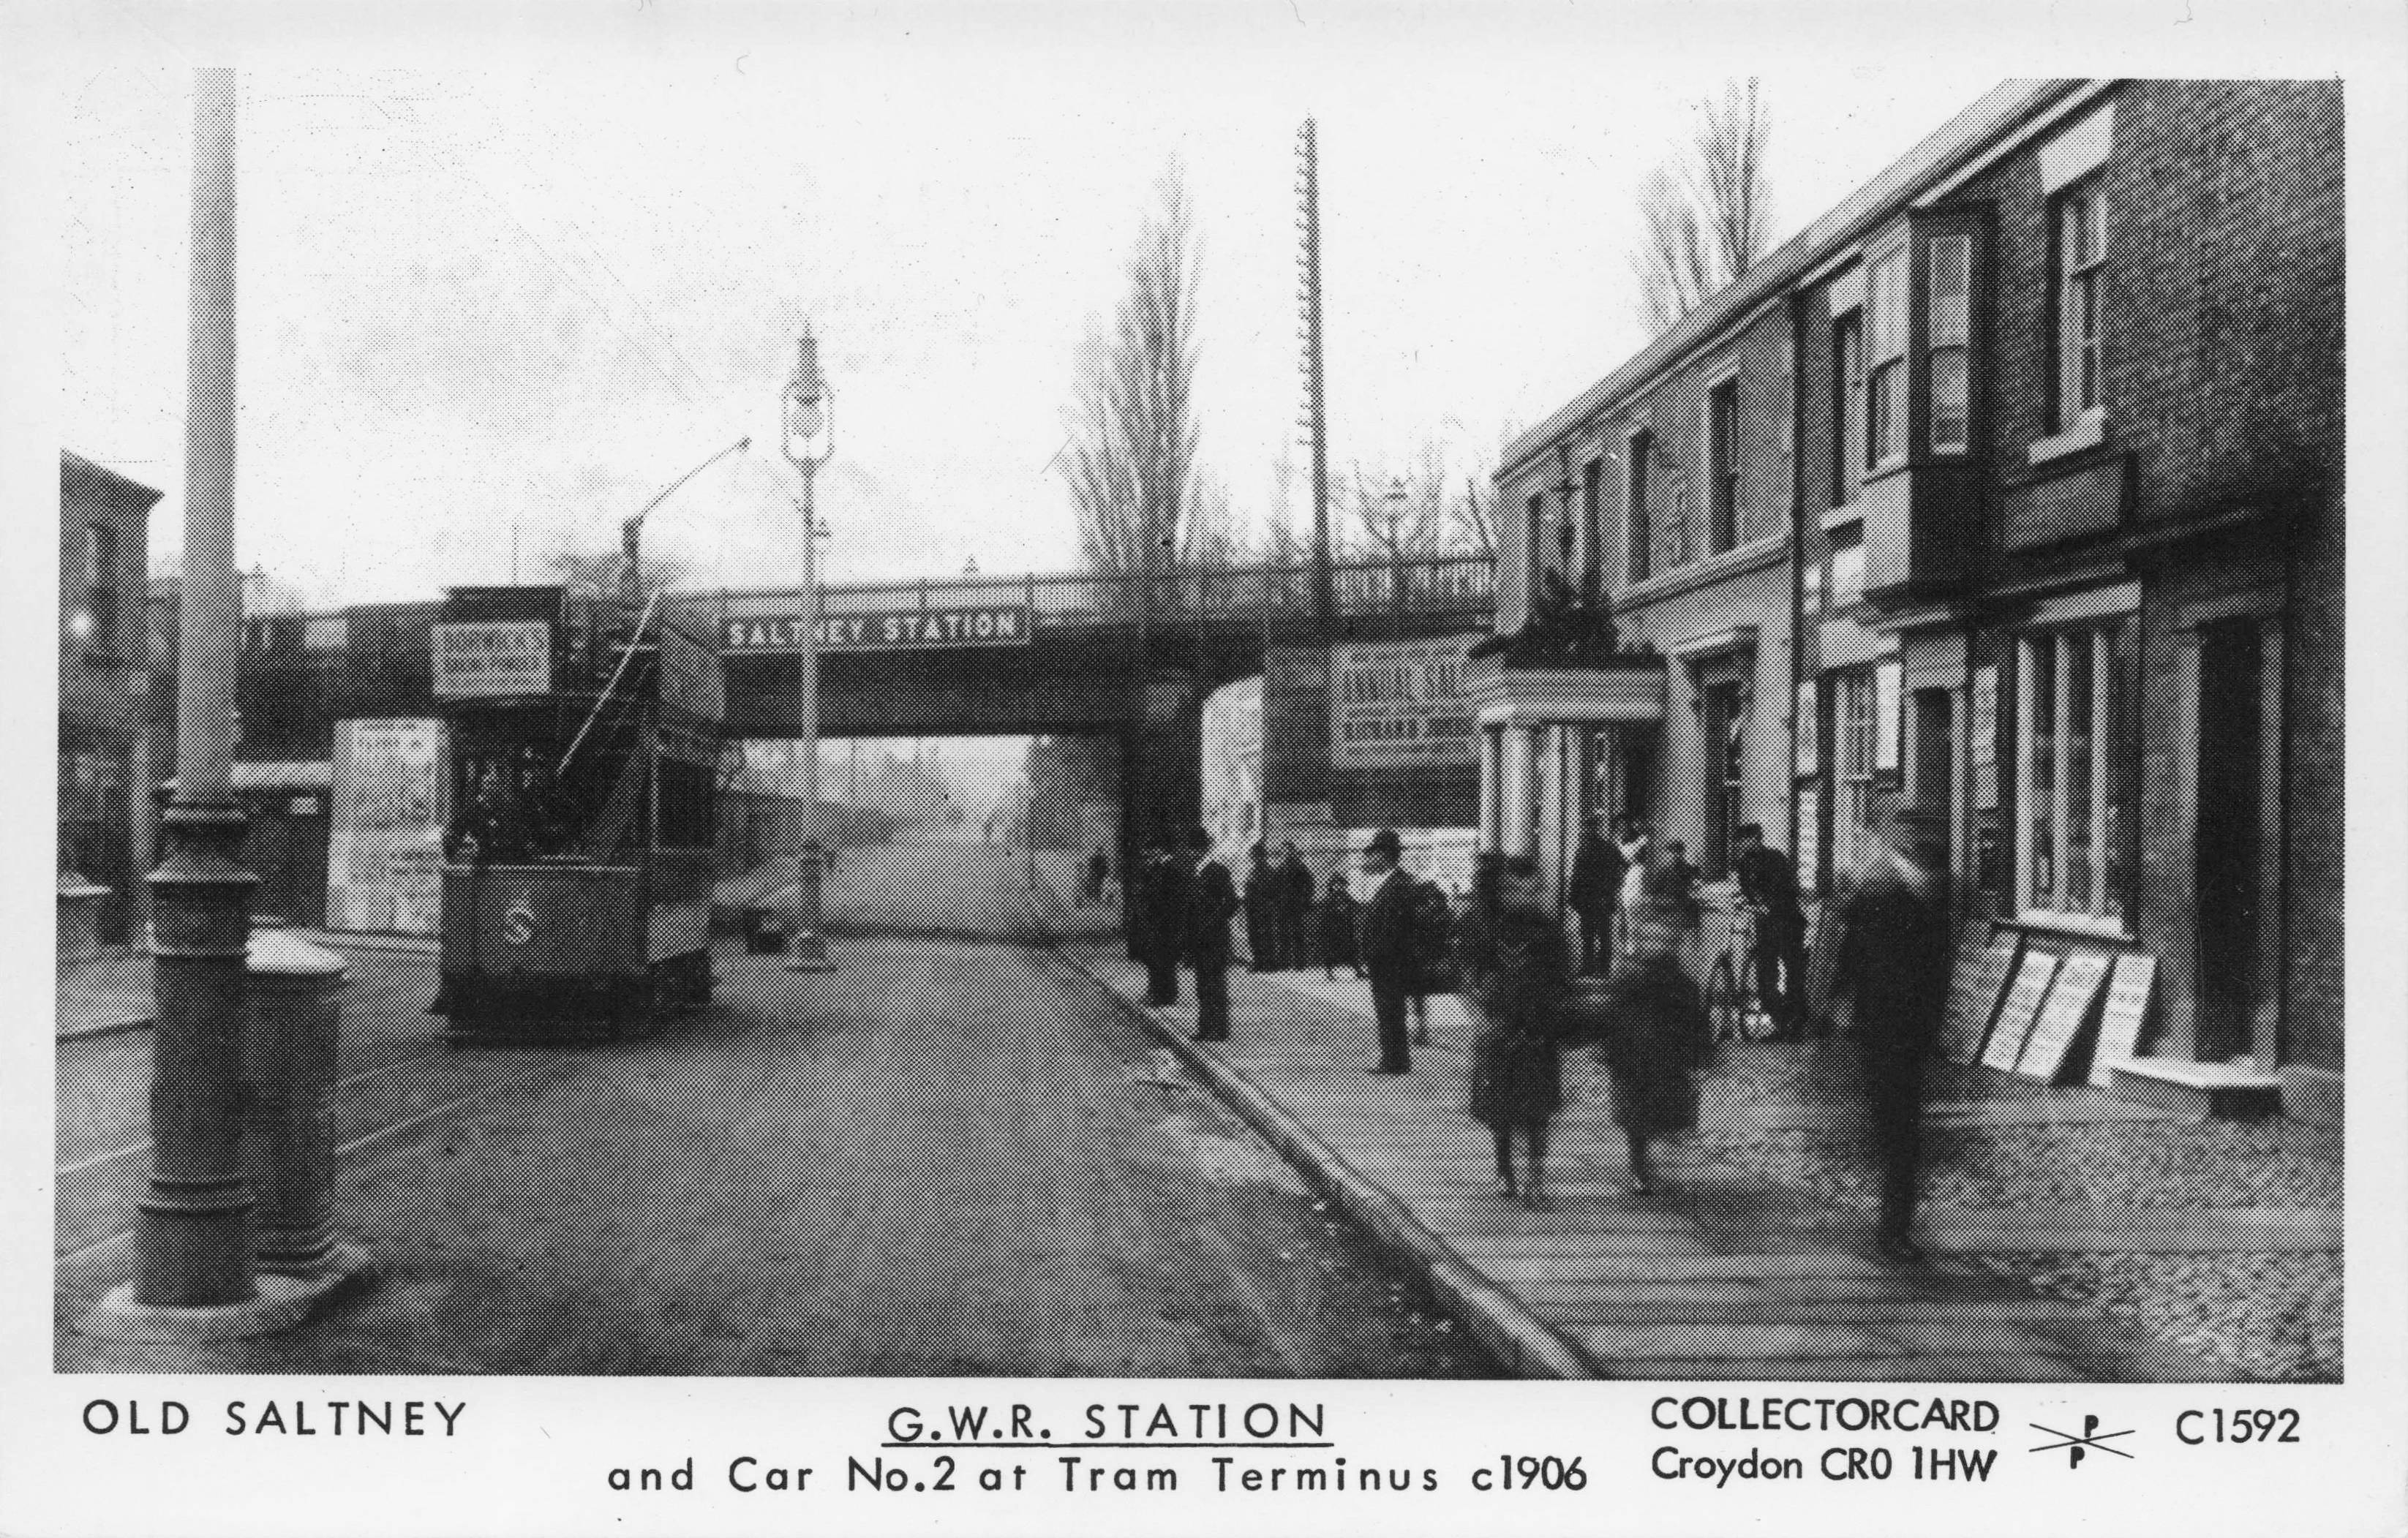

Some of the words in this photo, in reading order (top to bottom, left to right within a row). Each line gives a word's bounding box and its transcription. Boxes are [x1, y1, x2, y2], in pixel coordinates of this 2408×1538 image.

[728, 618, 865, 646] SALTNEY
[882, 612, 1017, 641] STATION
[1343, 666, 1416, 703] ANNUAL
